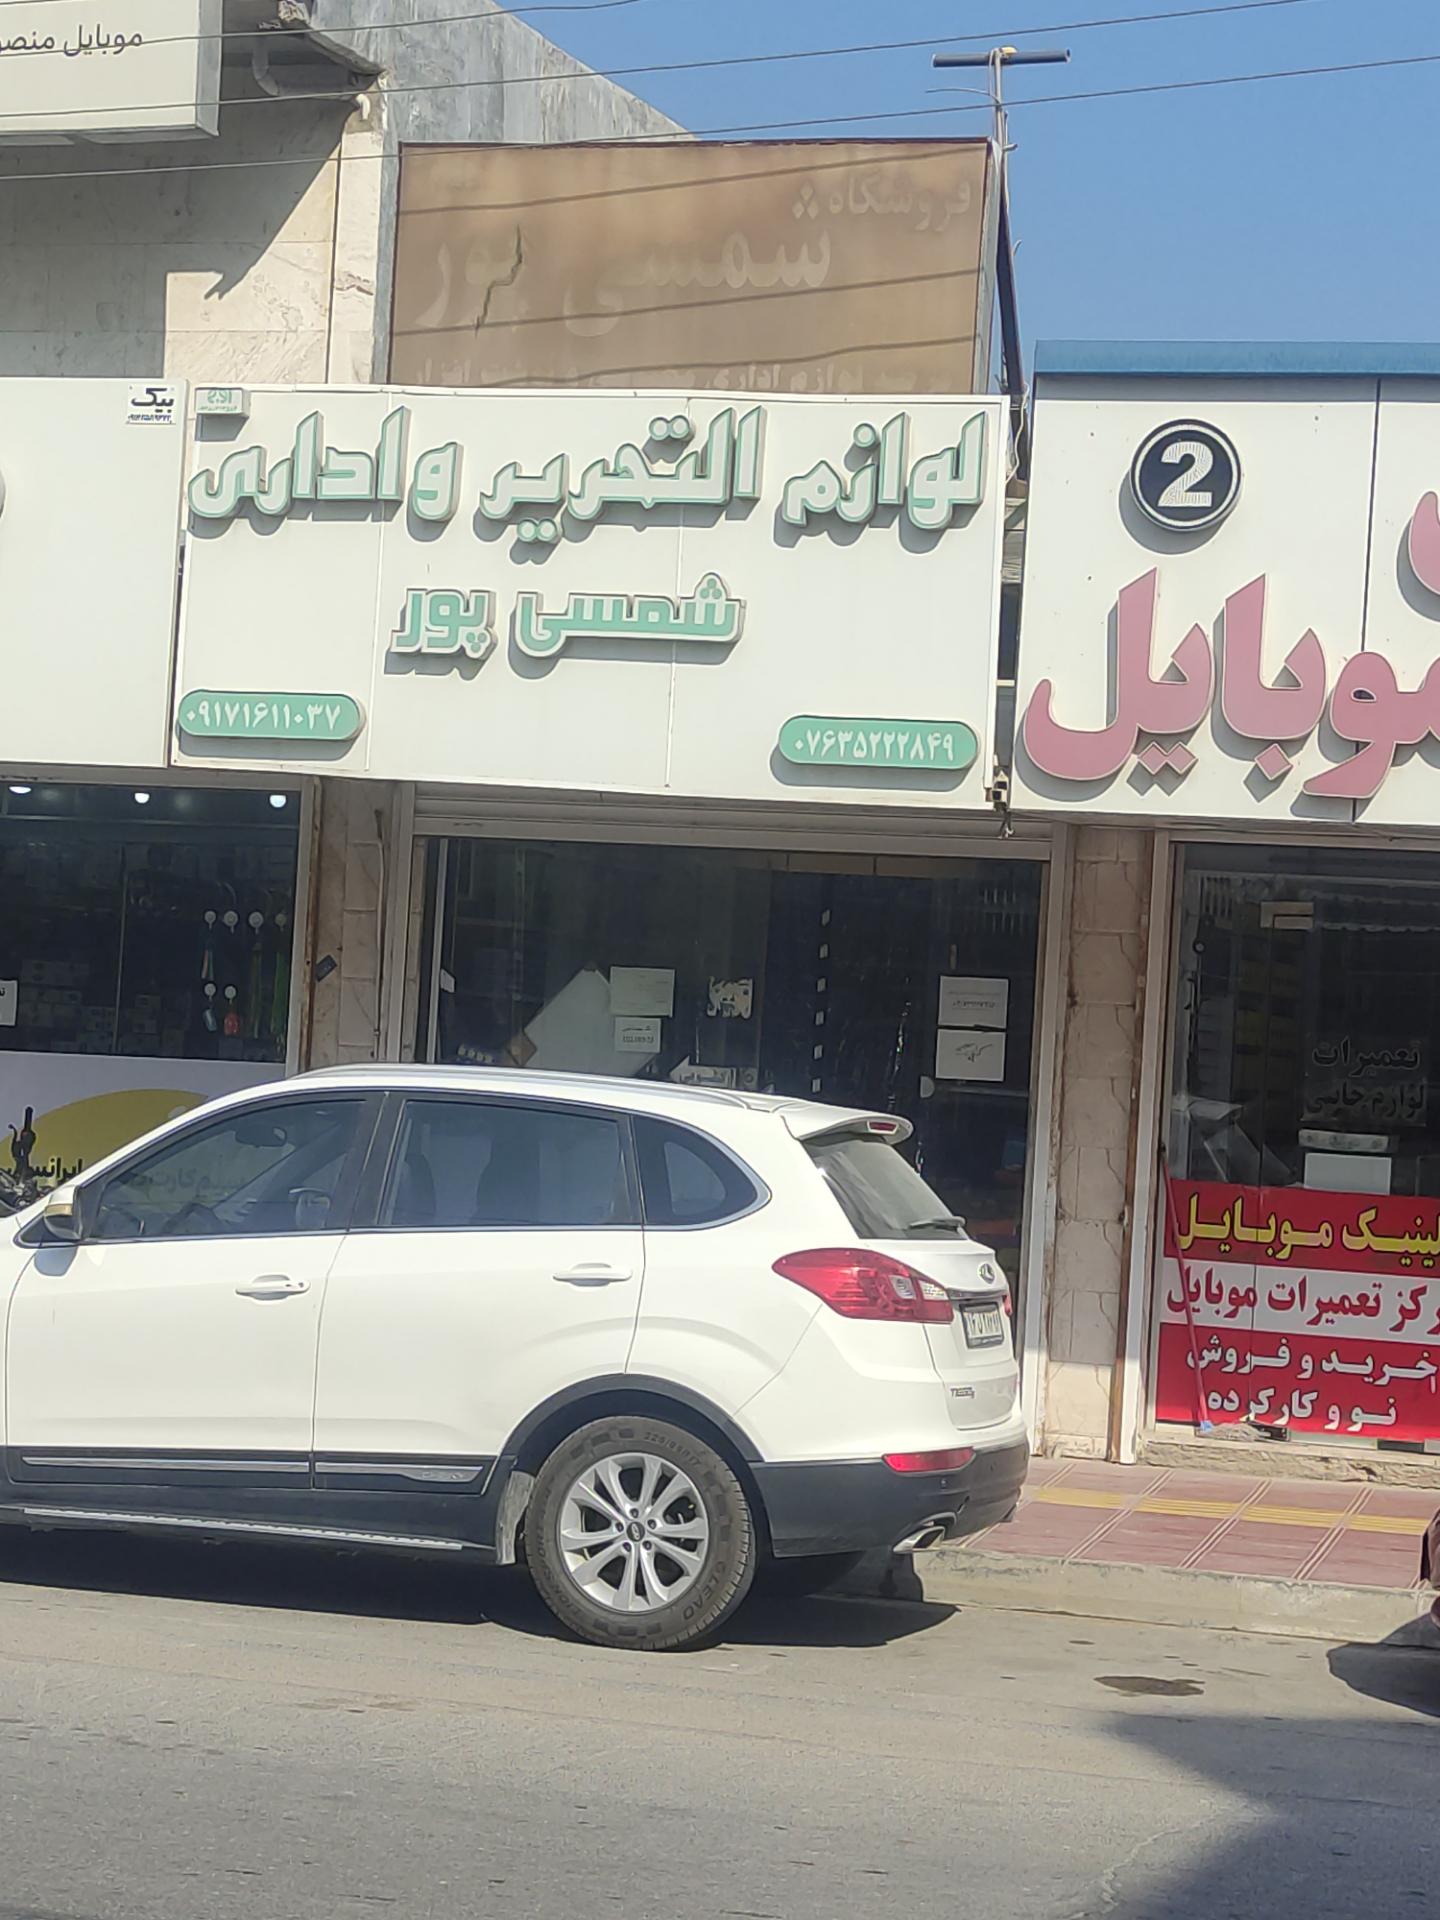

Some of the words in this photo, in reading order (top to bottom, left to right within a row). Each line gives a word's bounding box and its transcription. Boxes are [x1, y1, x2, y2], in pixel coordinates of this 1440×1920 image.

[0, 31, 55, 54] منص
[63, 23, 143, 57] موبایل
[828, 173, 971, 232] فروشگاه
[131, 387, 174, 413] بیک
[479, 405, 767, 544] التحریر
[782, 411, 988, 530] لوازم
[1157, 441, 1213, 507] 2
[391, 588, 497, 659] پور
[515, 572, 746, 658] شمسی
[186, 700, 341, 732] ۰۹۱۷۱۶۱۱۰۳۷
[795, 729, 954, 761] ۰۷۶۳۵۲۲۲۸۴۹
[1312, 1036, 1421, 1077] تعمیرات
[1176, 1192, 1334, 1260] موبایل
[1342, 1207, 1440, 1266] ینیک
[1167, 1266, 1258, 1319] موبایل
[1267, 1275, 1382, 1326] تعمیرات
[1388, 1284, 1440, 1336] رکز
[1187, 1335, 1292, 1374] فروش
[1297, 1354, 1314, 1379] و
[1321, 1350, 1438, 1386] خرید
[1324, 1403, 1341, 1430] و
[1347, 1397, 1398, 1432] نو
